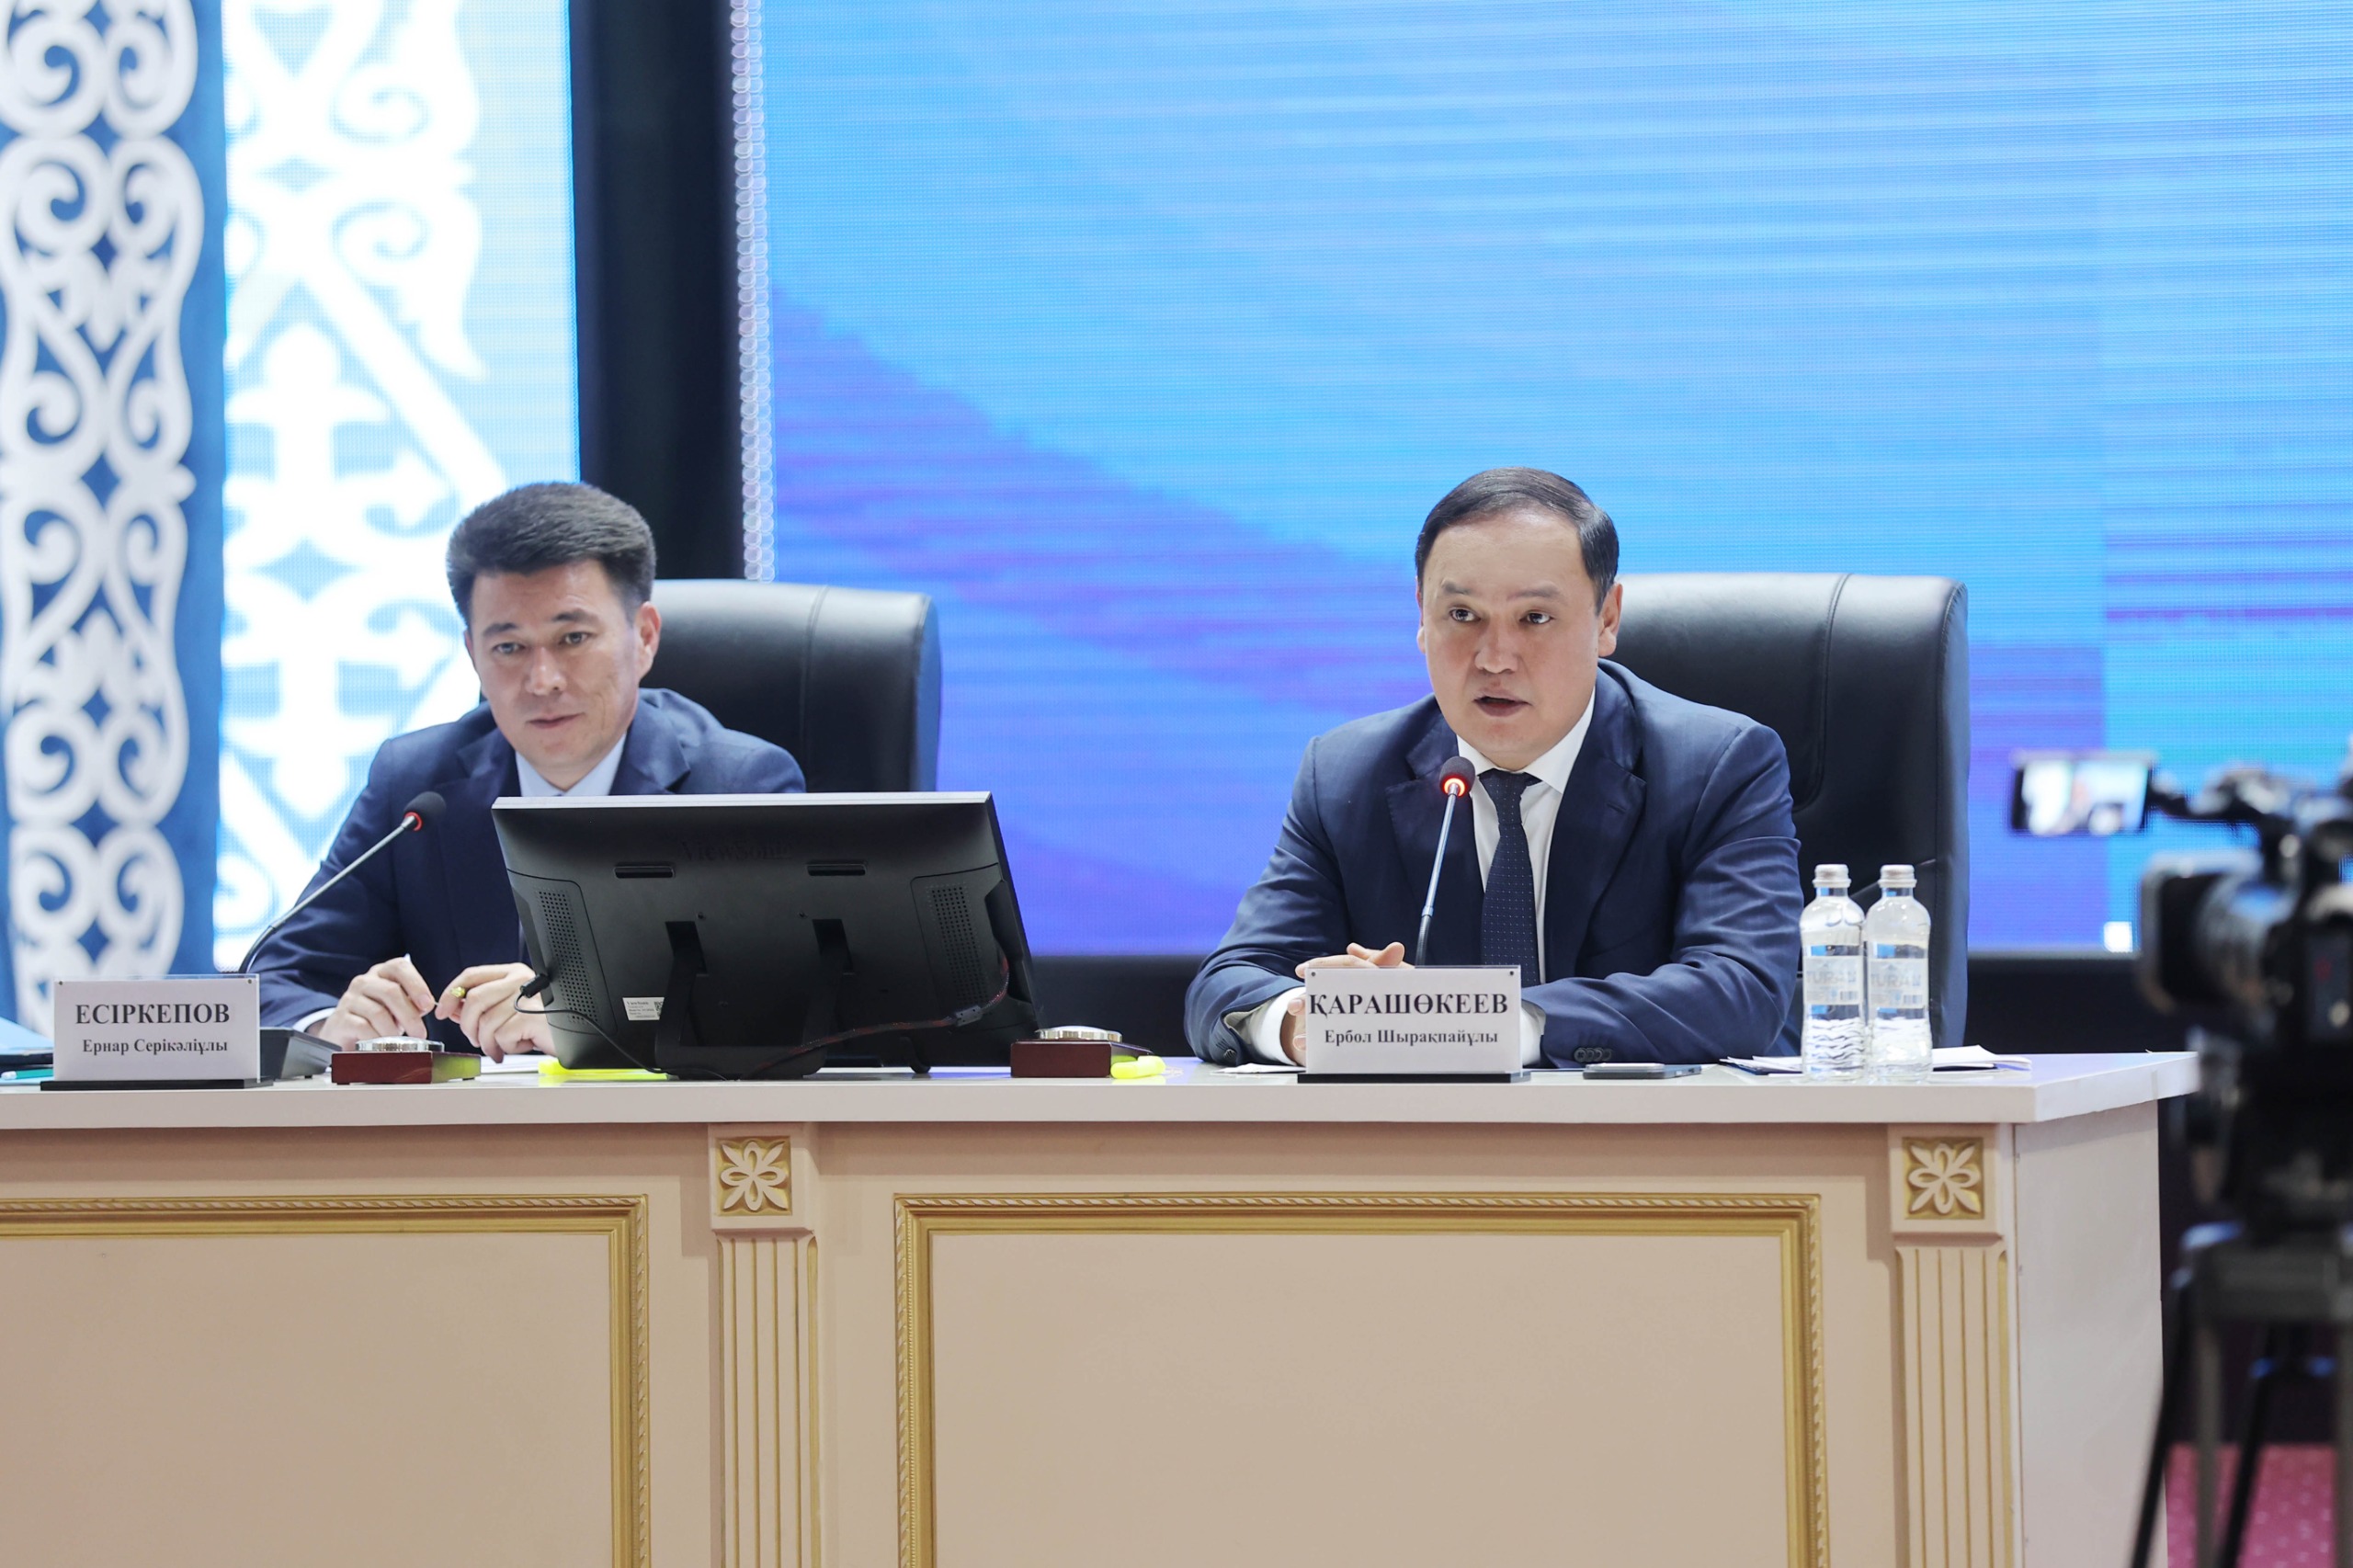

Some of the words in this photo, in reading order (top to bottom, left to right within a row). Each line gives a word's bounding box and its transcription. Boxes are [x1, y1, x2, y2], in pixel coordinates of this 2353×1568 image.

[75, 1003, 230, 1024] ЕСІРКЕПОВ
[1309, 994, 1508, 1018] ҚАРАШӨКЕЕВ
[1324, 1029, 1372, 1046] Ербол
[1378, 1029, 1498, 1046] Шырақпайұлы
[83, 1039, 130, 1056] Ернар
[133, 1039, 228, 1055] Серікәліұлы
